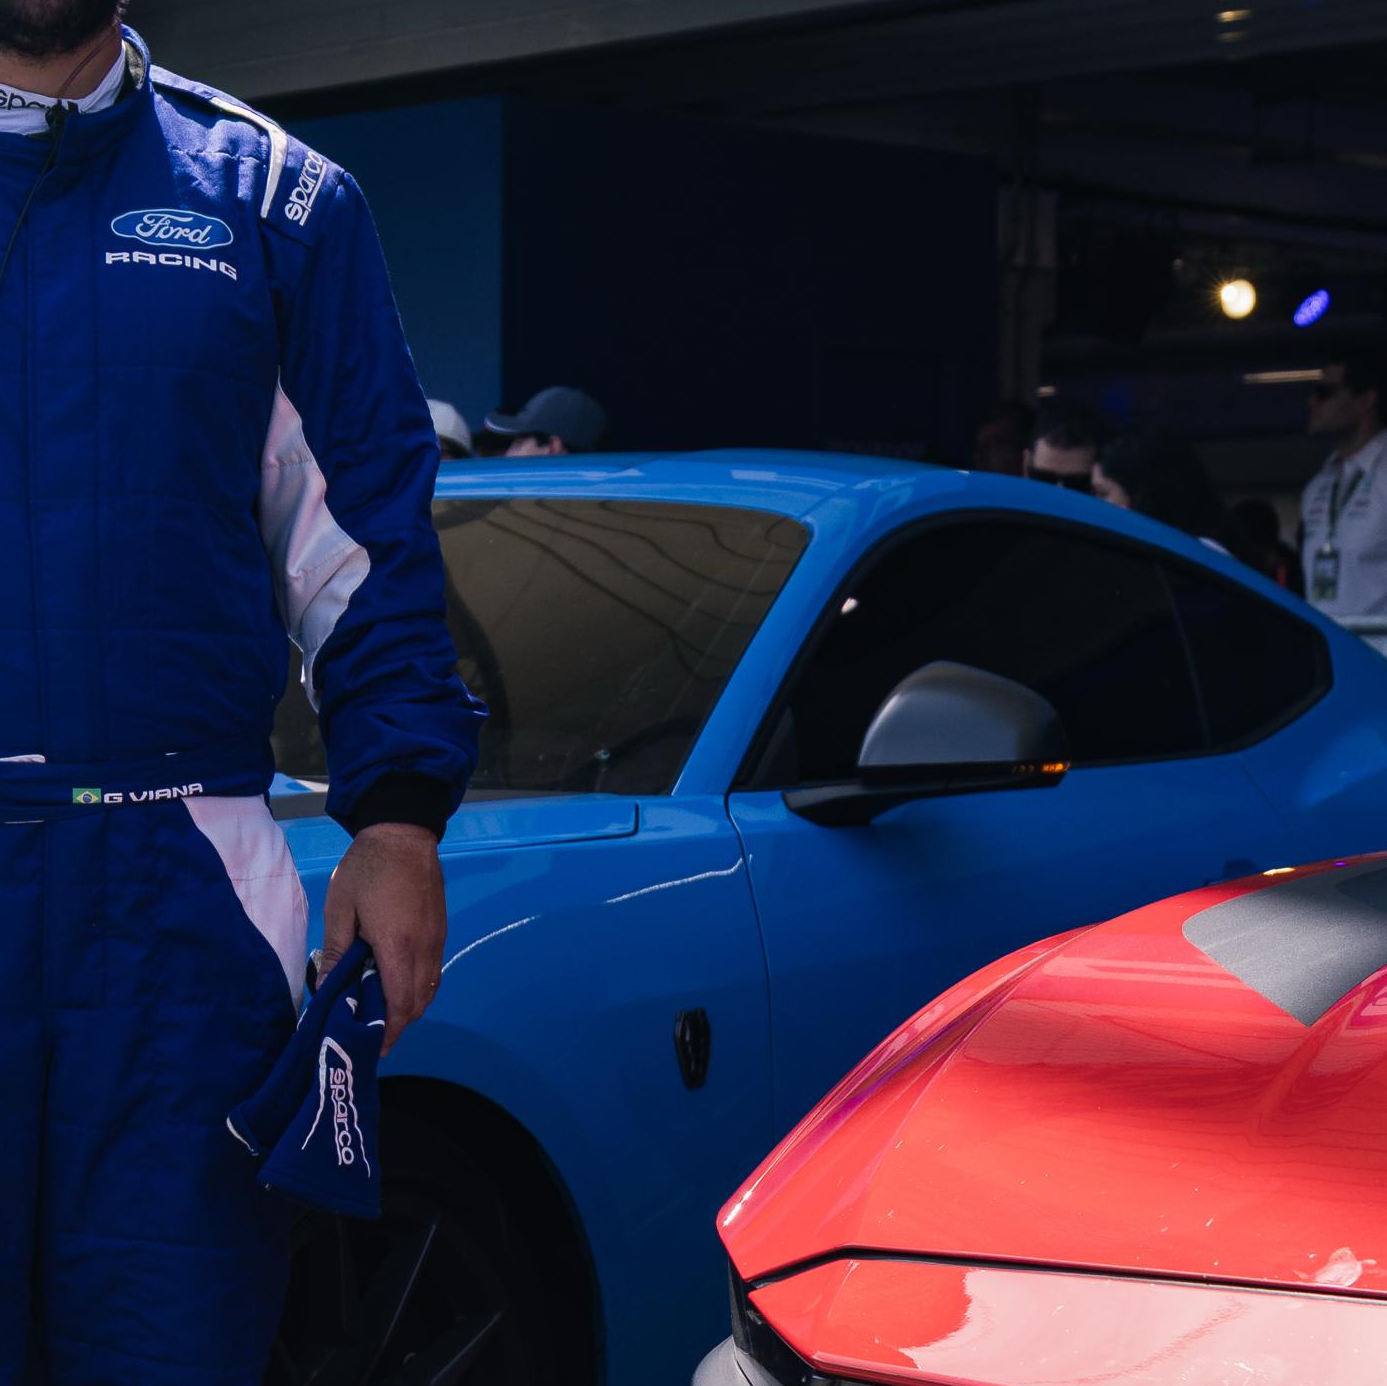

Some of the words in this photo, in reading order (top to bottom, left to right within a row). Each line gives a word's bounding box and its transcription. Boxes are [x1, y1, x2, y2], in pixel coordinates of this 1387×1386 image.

[284, 150, 325, 223] sparco
[135, 213, 212, 244] Ford
[105, 251, 237, 281] RACING
[103, 792, 123, 804] G
[129, 782, 204, 802] VIANA
[330, 1067, 354, 1165] sparco
